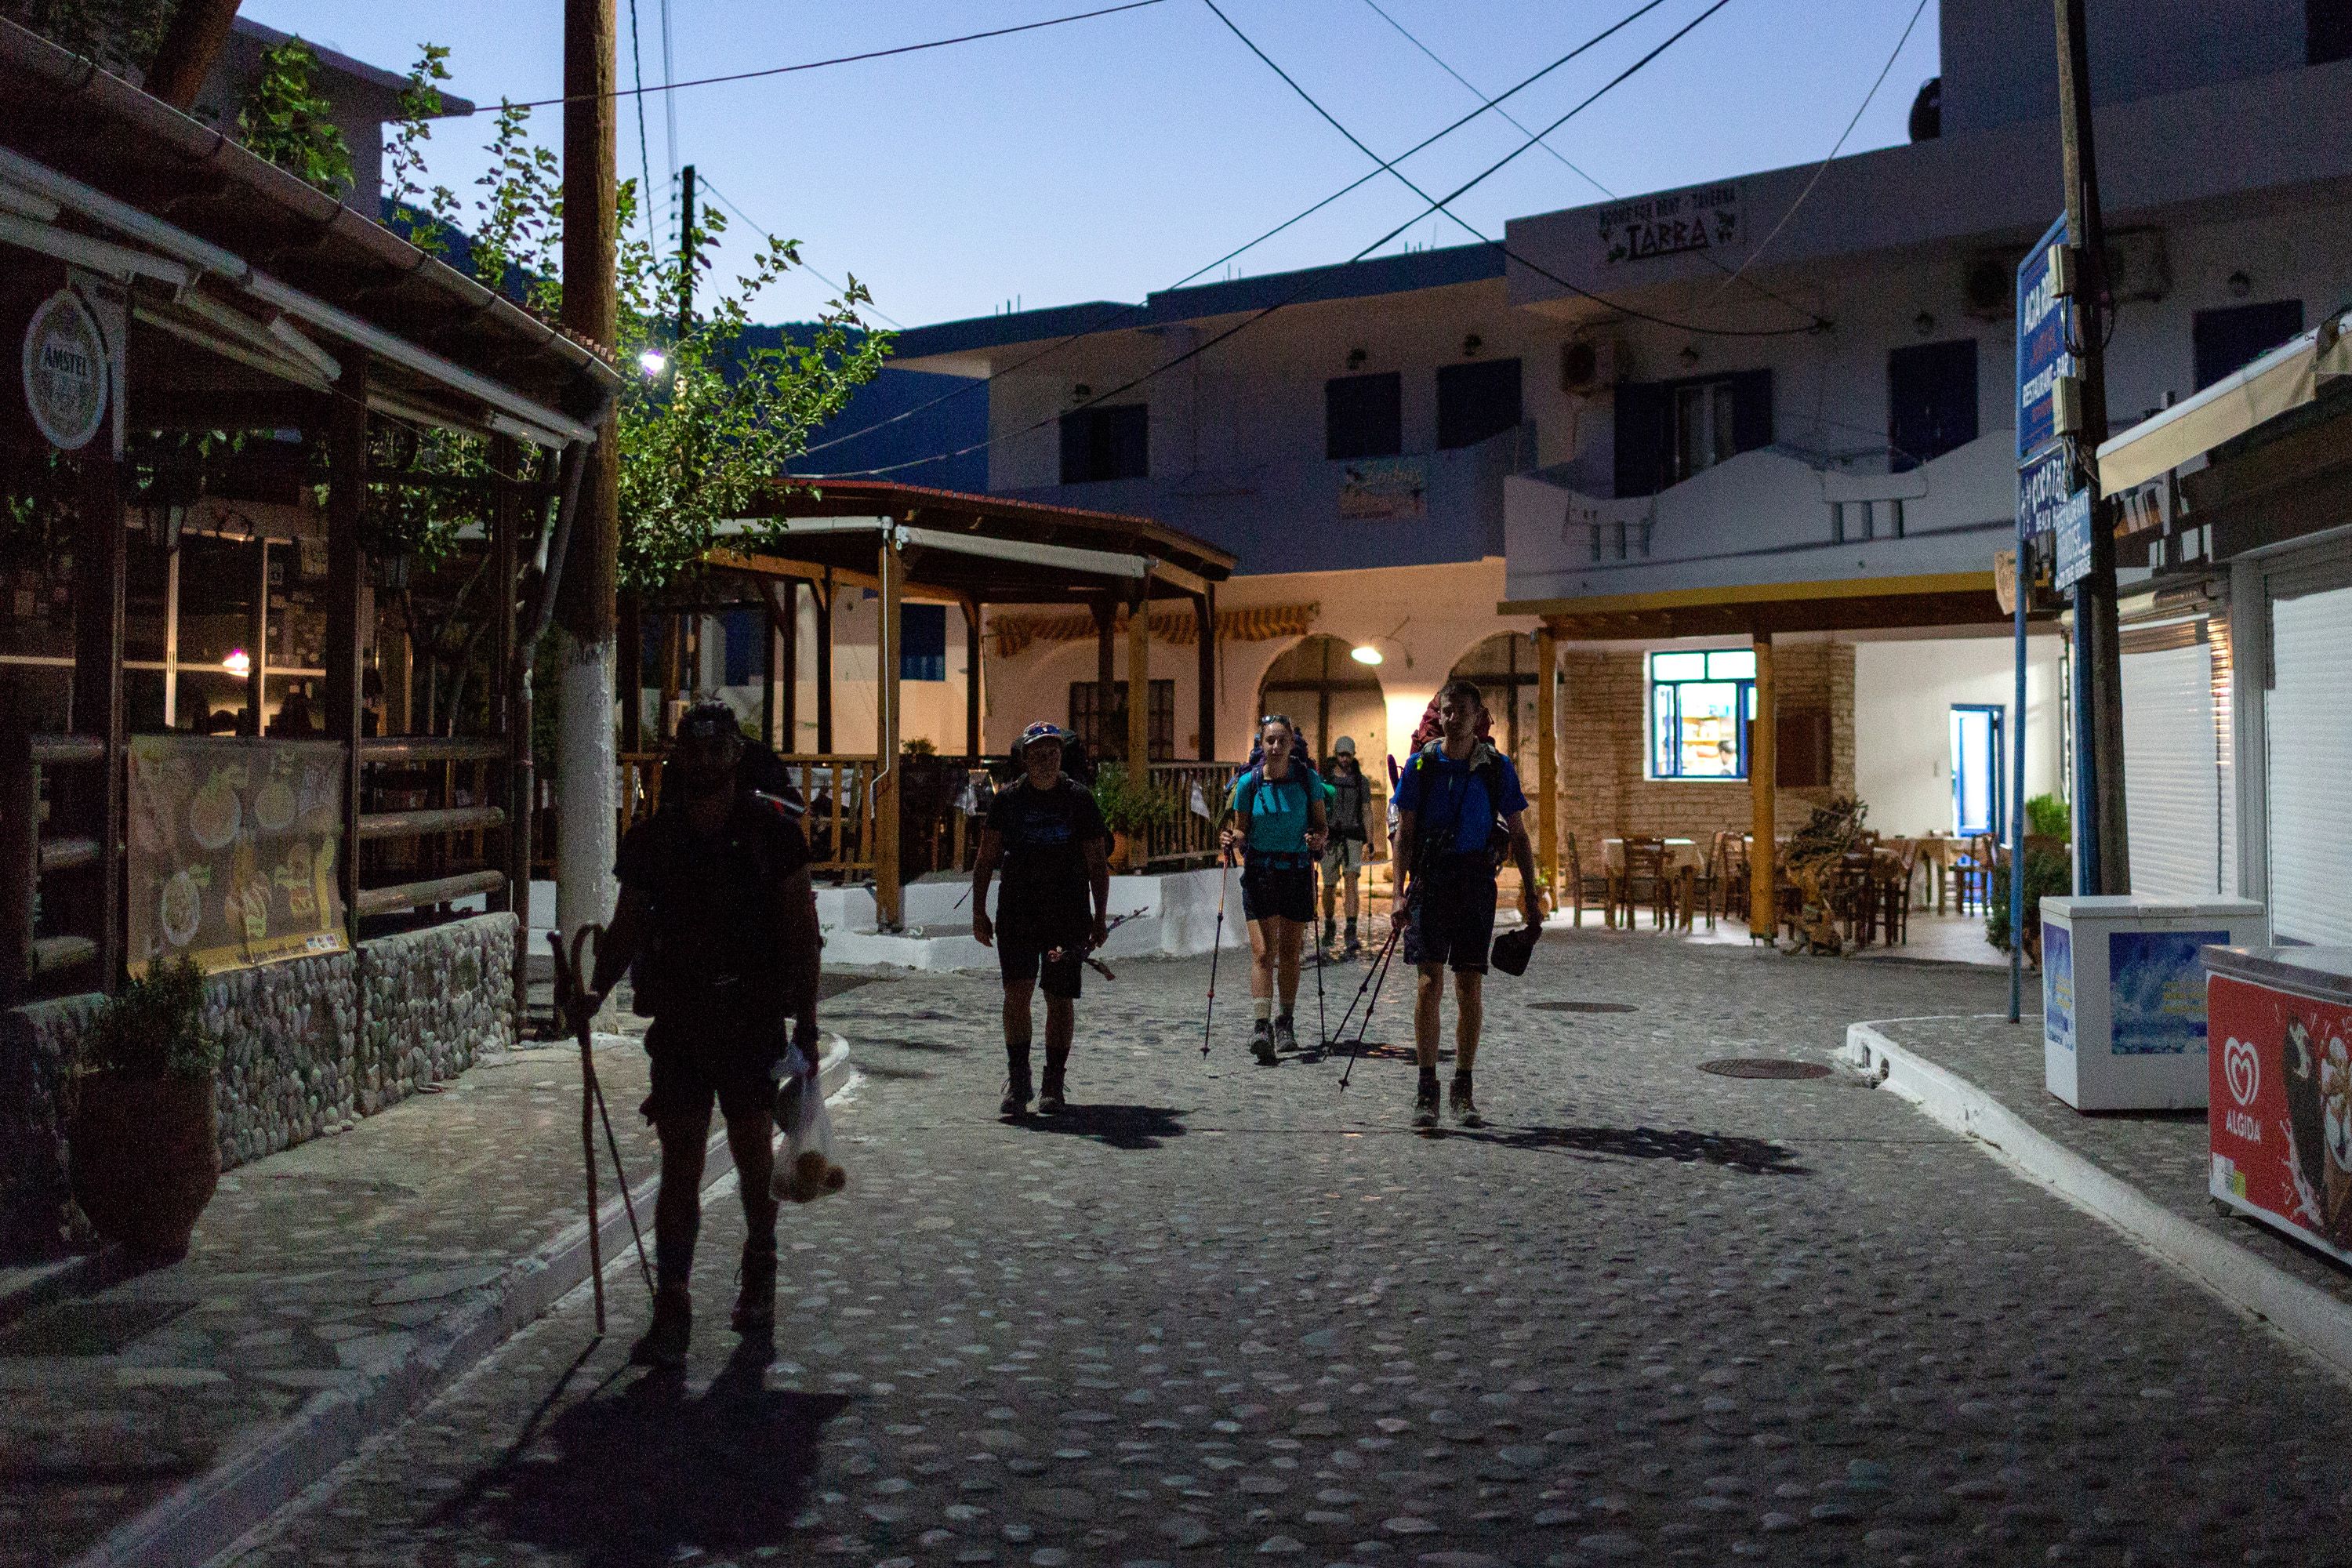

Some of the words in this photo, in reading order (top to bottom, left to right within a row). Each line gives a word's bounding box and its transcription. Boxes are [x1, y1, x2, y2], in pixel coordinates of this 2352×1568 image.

[1625, 217, 1711, 262] TARRA
[44, 346, 88, 376] AMSTEL
[2226, 1109, 2262, 1145] ALGIDA
